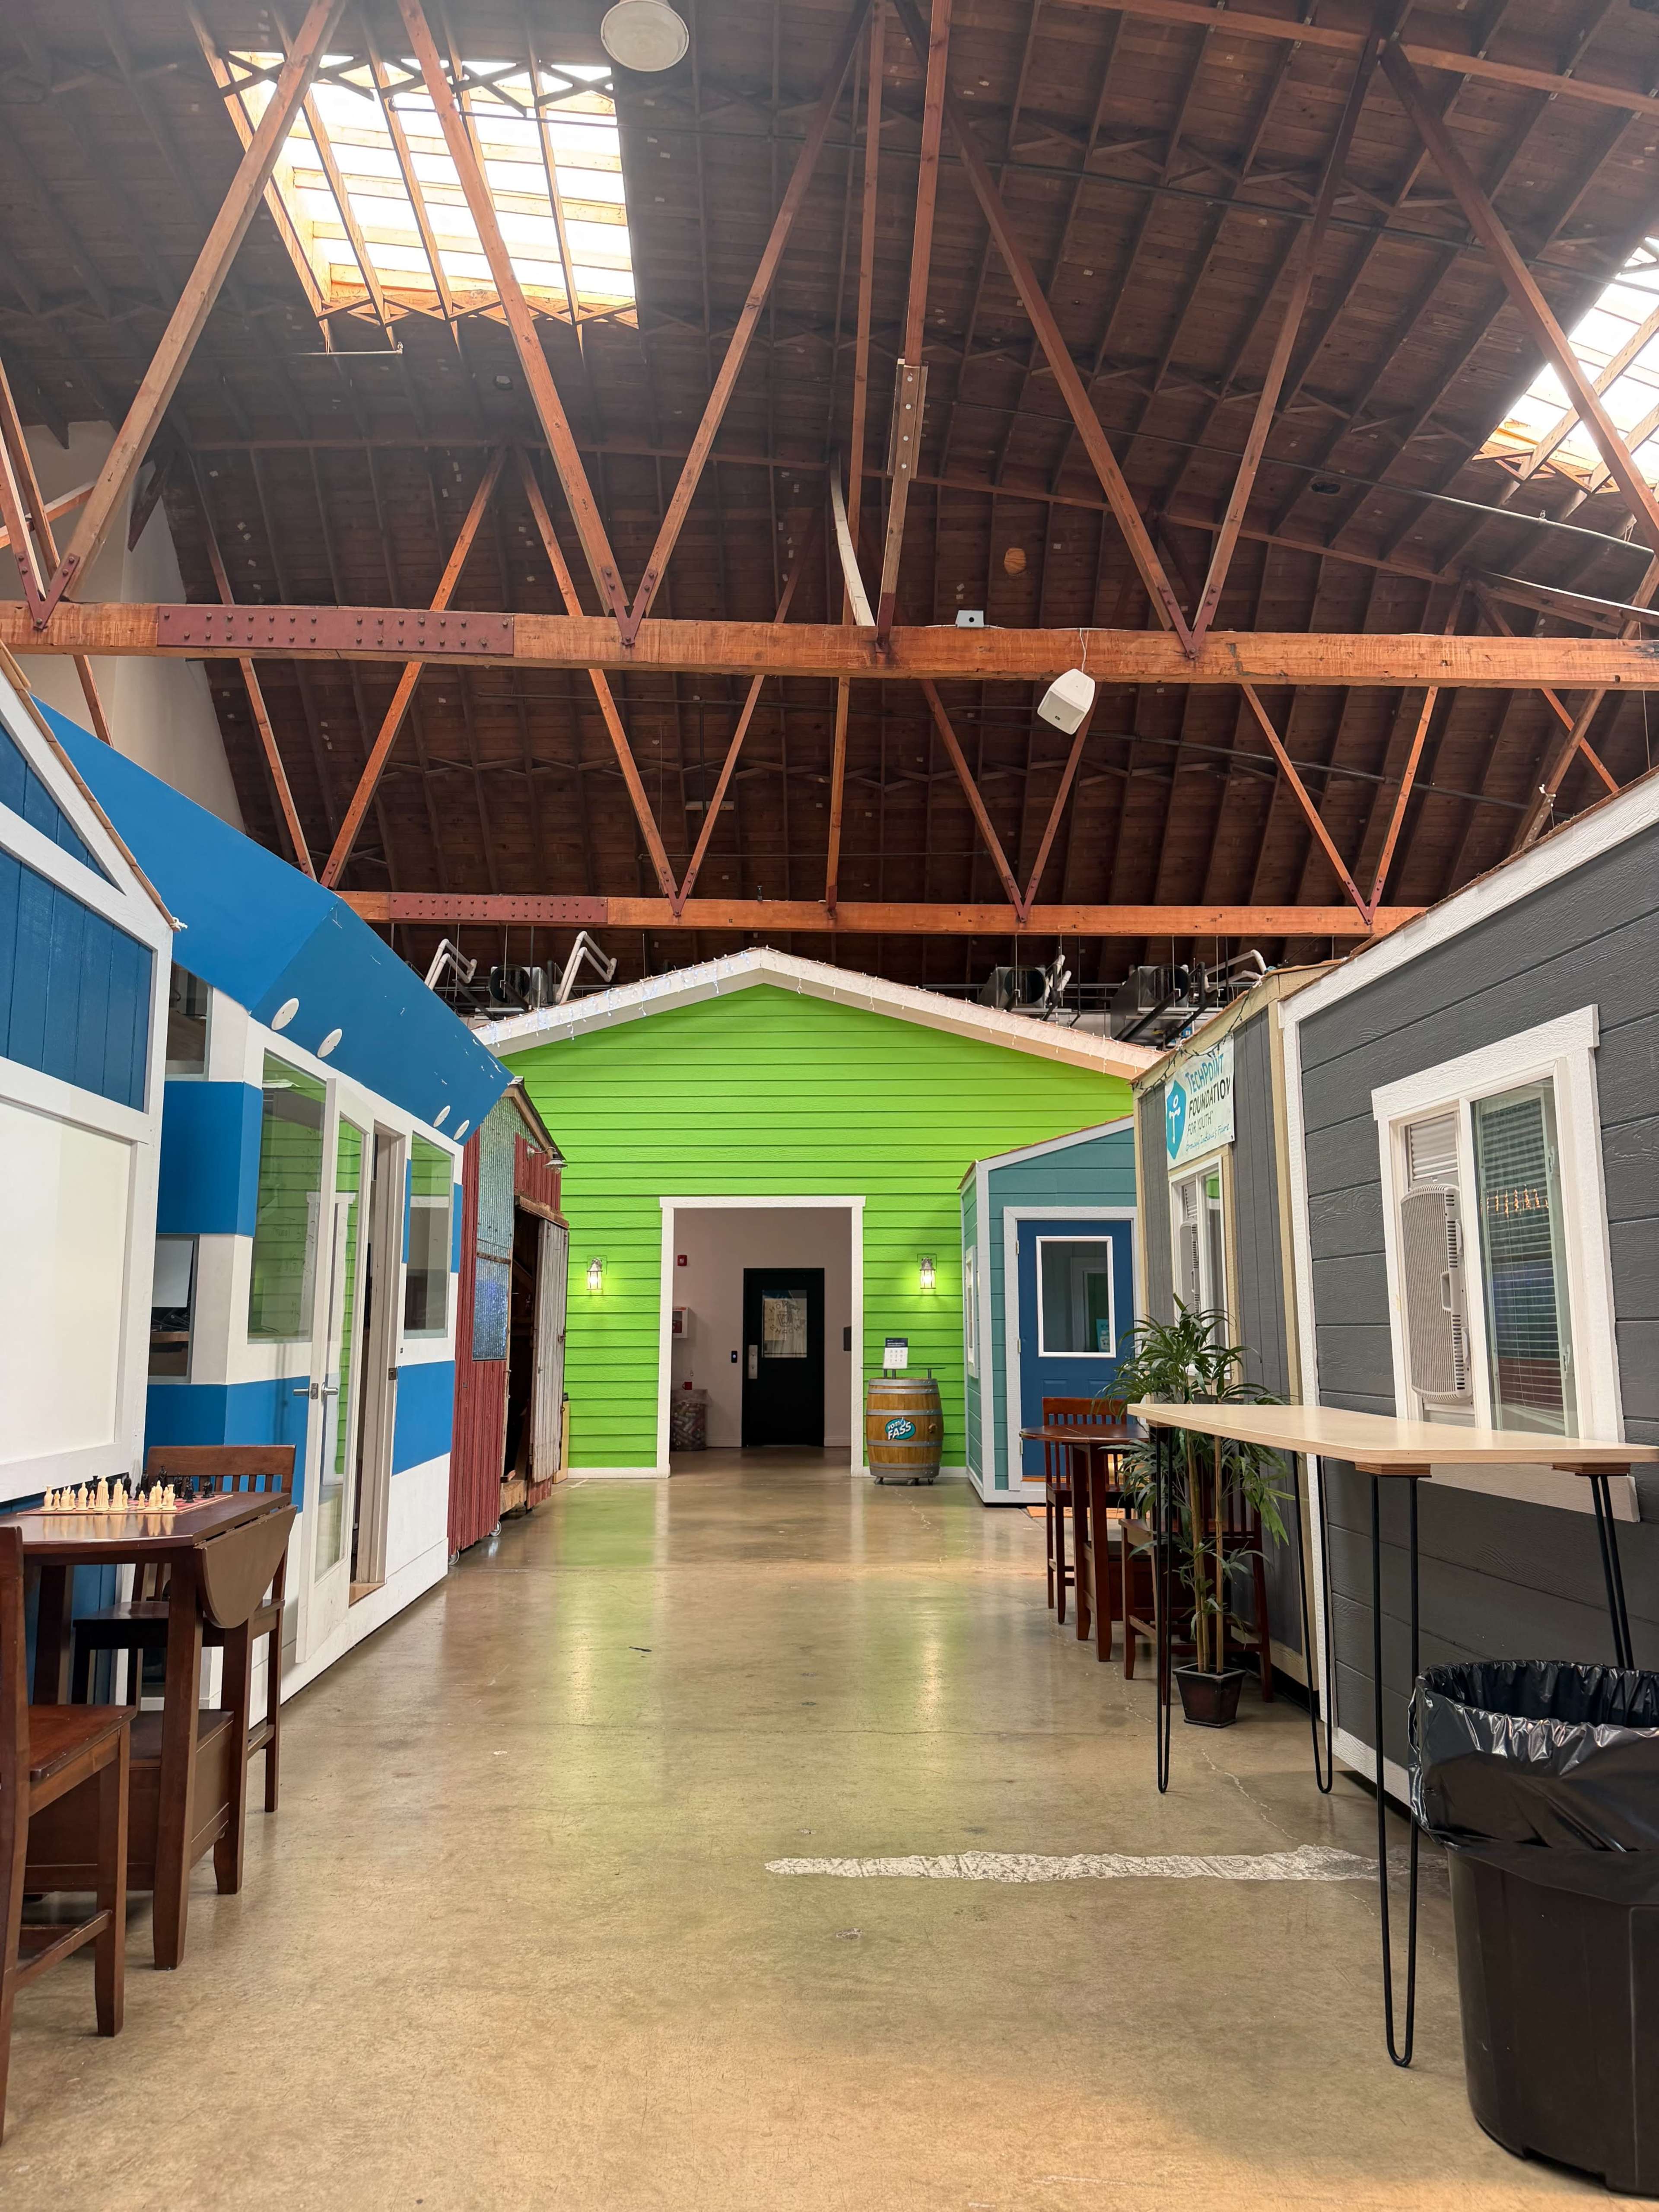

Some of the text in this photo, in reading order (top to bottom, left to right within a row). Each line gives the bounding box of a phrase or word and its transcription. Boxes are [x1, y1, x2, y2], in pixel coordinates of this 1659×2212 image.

[1187, 1120, 1196, 1136] FOR
[887, 1420, 900, 1430] vom
[888, 1421, 912, 1441] FASS
